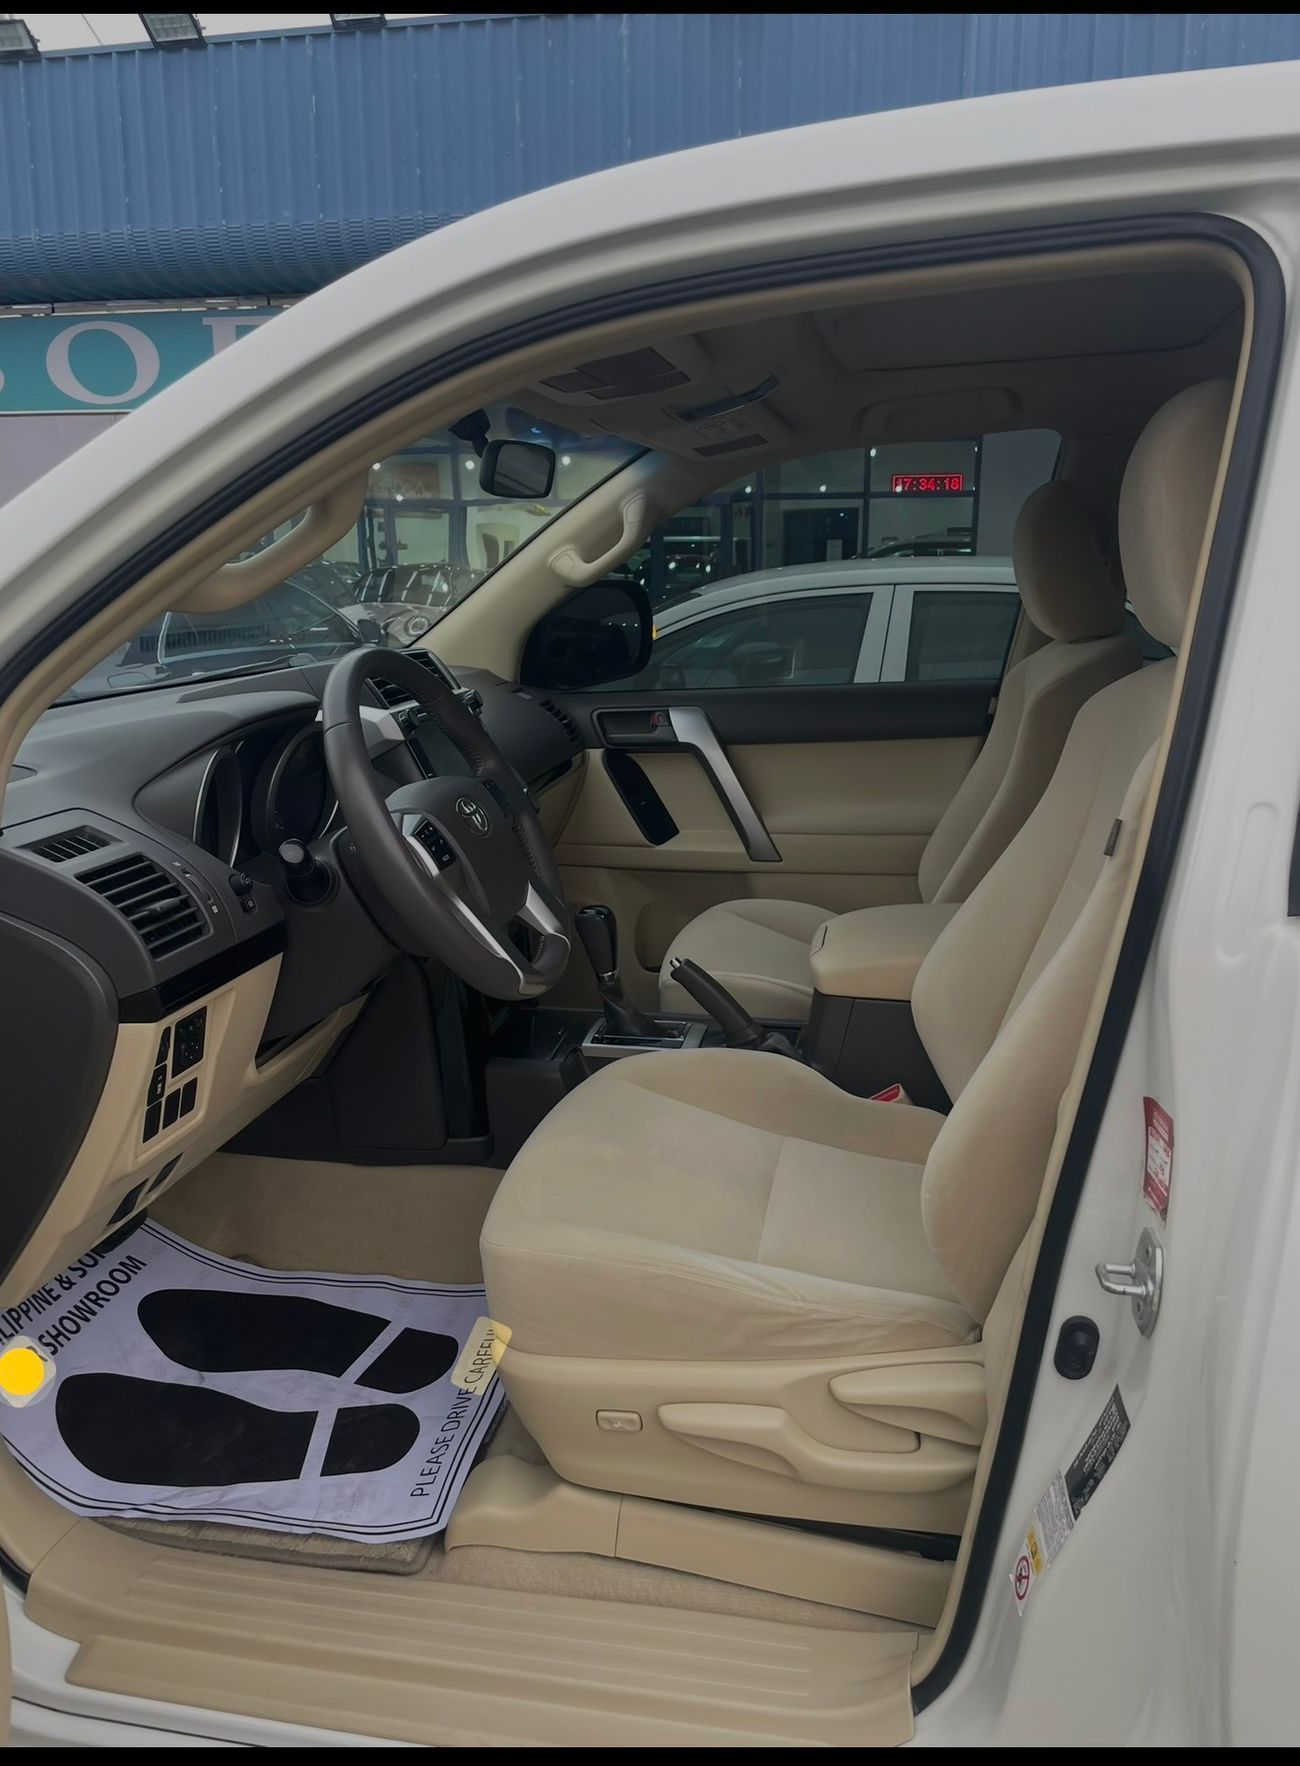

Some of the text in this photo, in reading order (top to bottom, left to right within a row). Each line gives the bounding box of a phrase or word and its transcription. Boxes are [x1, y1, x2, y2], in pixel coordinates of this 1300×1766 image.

[38, 1255, 148, 1356] SHOWROOM
[54, 1273, 77, 1291] &
[410, 1434, 455, 1497] PLEASE
[440, 1386, 478, 1433] DRIVE
